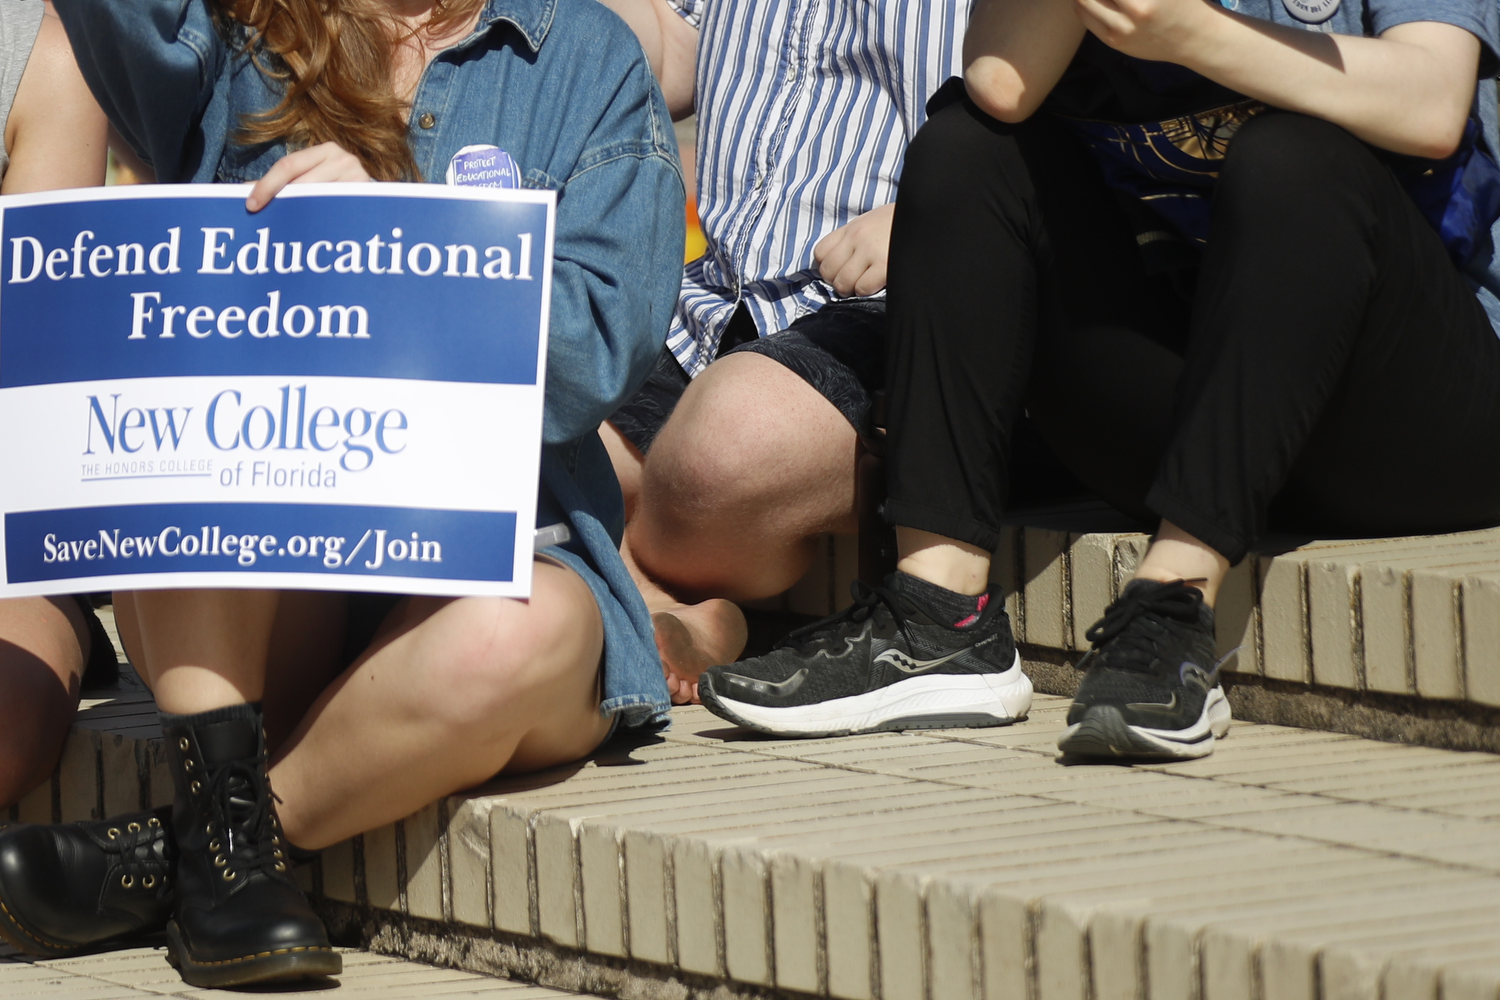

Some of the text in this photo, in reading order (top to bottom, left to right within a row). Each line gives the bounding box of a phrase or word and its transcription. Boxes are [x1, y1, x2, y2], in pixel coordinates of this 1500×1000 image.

[457, 168, 511, 183] EDUCATIONAL
[464, 156, 496, 170] PROTECT
[8, 226, 533, 284] Defend Educational
[127, 290, 371, 339] Freedom
[83, 383, 408, 471] New College
[81, 458, 337, 488] THE HONORS COLLEGE of Florida
[43, 525, 442, 570] SaveNewCollege.org/Join
